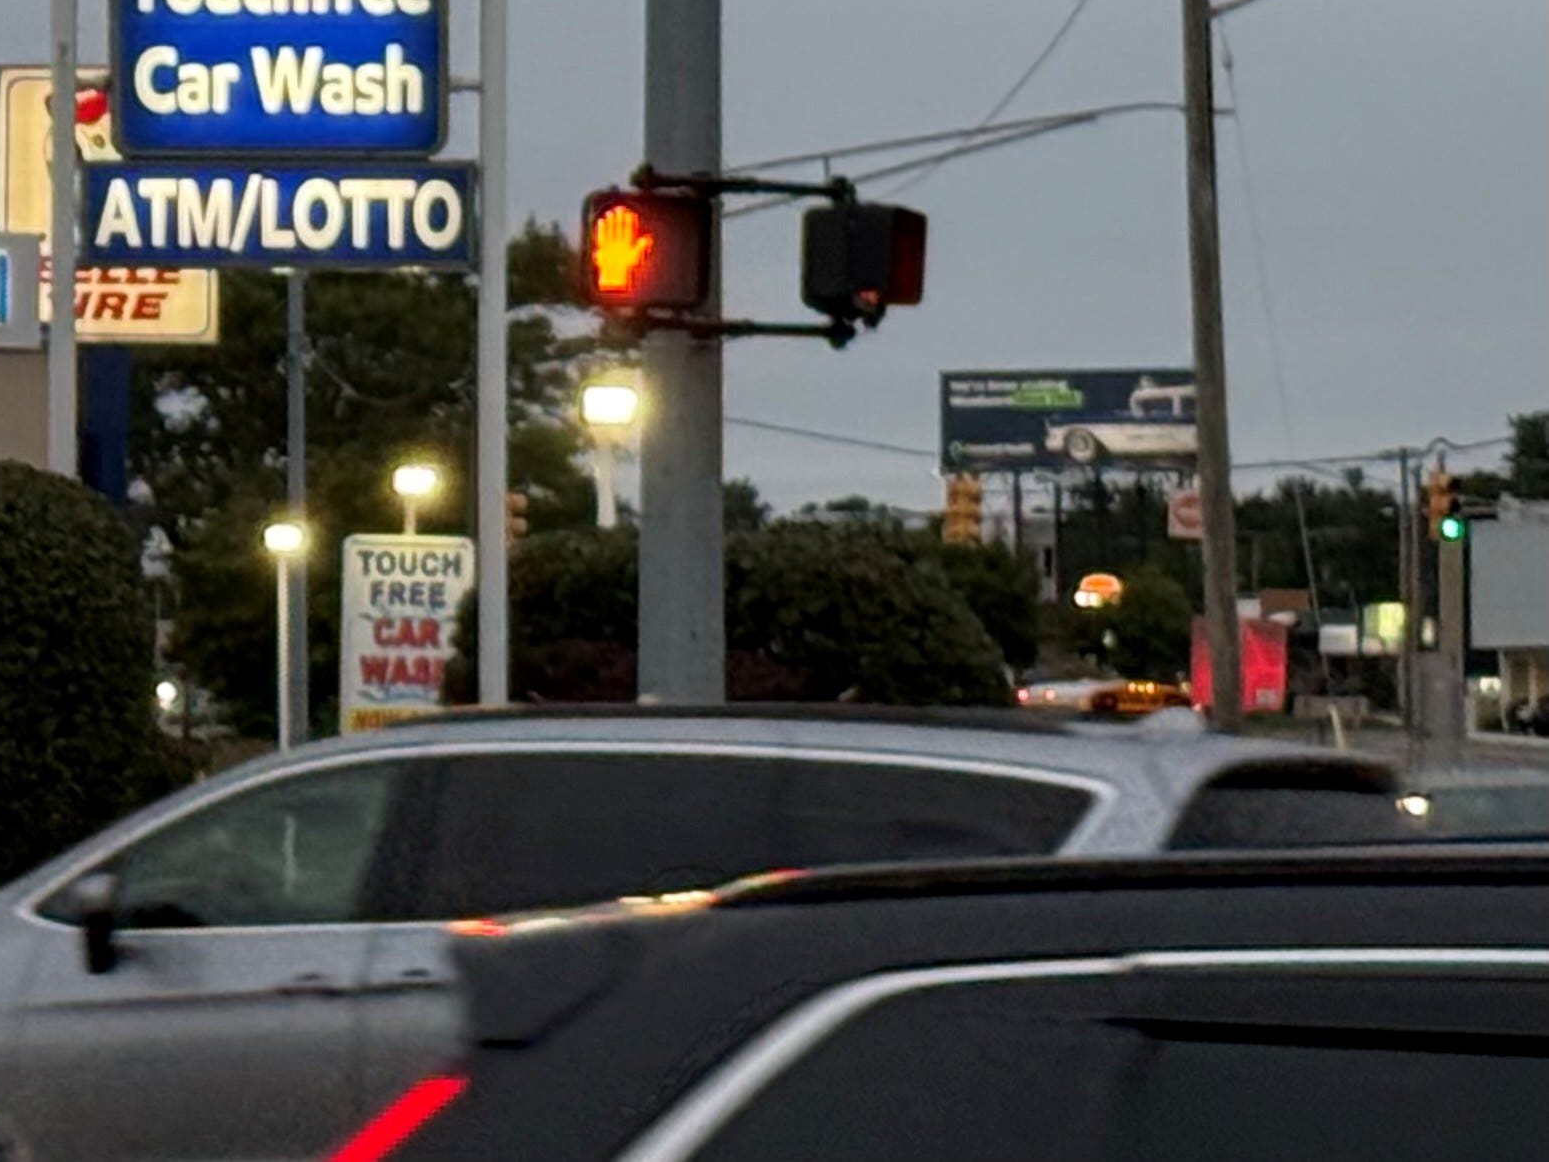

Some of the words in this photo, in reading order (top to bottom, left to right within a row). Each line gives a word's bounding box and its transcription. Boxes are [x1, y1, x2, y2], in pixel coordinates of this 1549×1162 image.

[134, 45, 240, 114] Car
[251, 44, 424, 114] Wash
[95, 174, 462, 253] ATM/LOTTO
[358, 550, 462, 577] TOUCH
[370, 581, 447, 609] FREE
[373, 617, 440, 649] CAR
